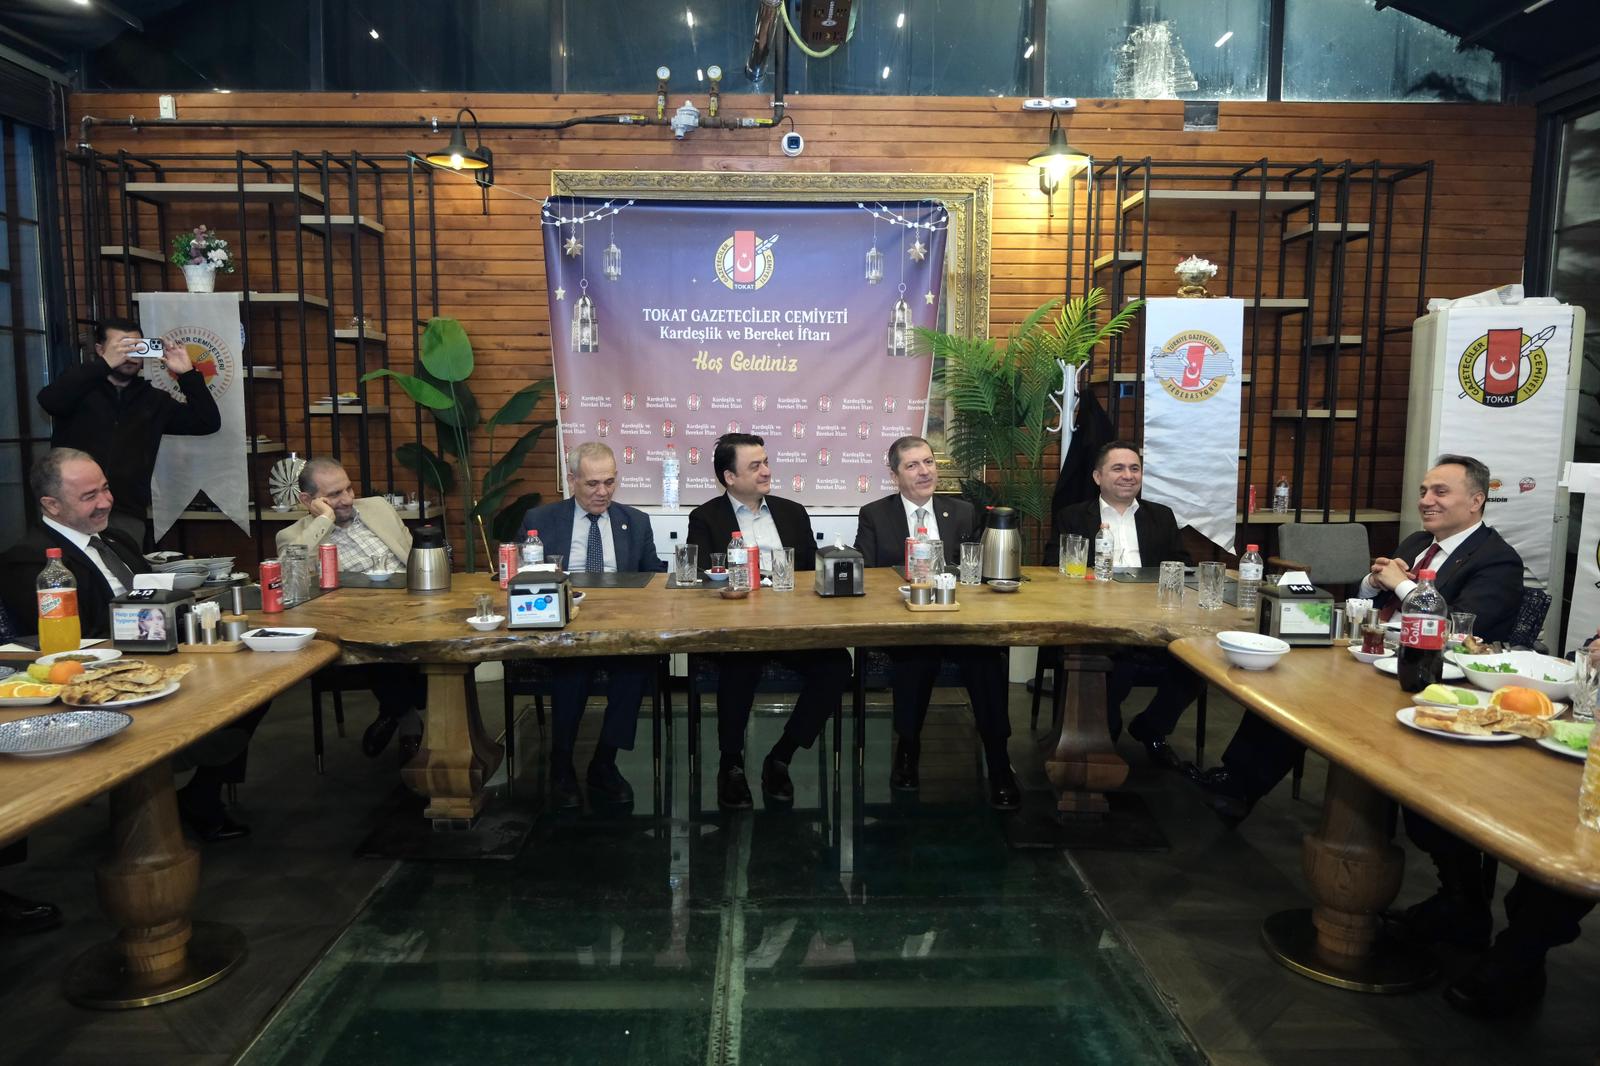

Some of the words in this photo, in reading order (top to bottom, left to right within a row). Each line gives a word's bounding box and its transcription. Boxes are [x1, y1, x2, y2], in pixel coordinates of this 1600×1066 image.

[716, 243, 729, 283] GAZETECİLER
[759, 255, 773, 284] CEMİYETİ
[643, 308, 687, 322] TOKAT
[691, 307, 781, 323] GAZETECİLER
[785, 308, 848, 324] CEMİYETİ
[660, 326, 722, 344] Kardeşlik
[727, 329, 741, 340] ve
[744, 327, 794, 341] Bereket
[798, 325, 830, 341] İftarı
[692, 350, 723, 373] Hoş
[730, 350, 798, 372] Geldiniz
[1463, 342, 1485, 396] GAZETECİLER
[1523, 353, 1543, 395] CEMİYETİ
[1168, 382, 1218, 399] FEDERASYONU
[1486, 395, 1515, 404] TOKAT
[1408, 622, 1420, 645] Cola
